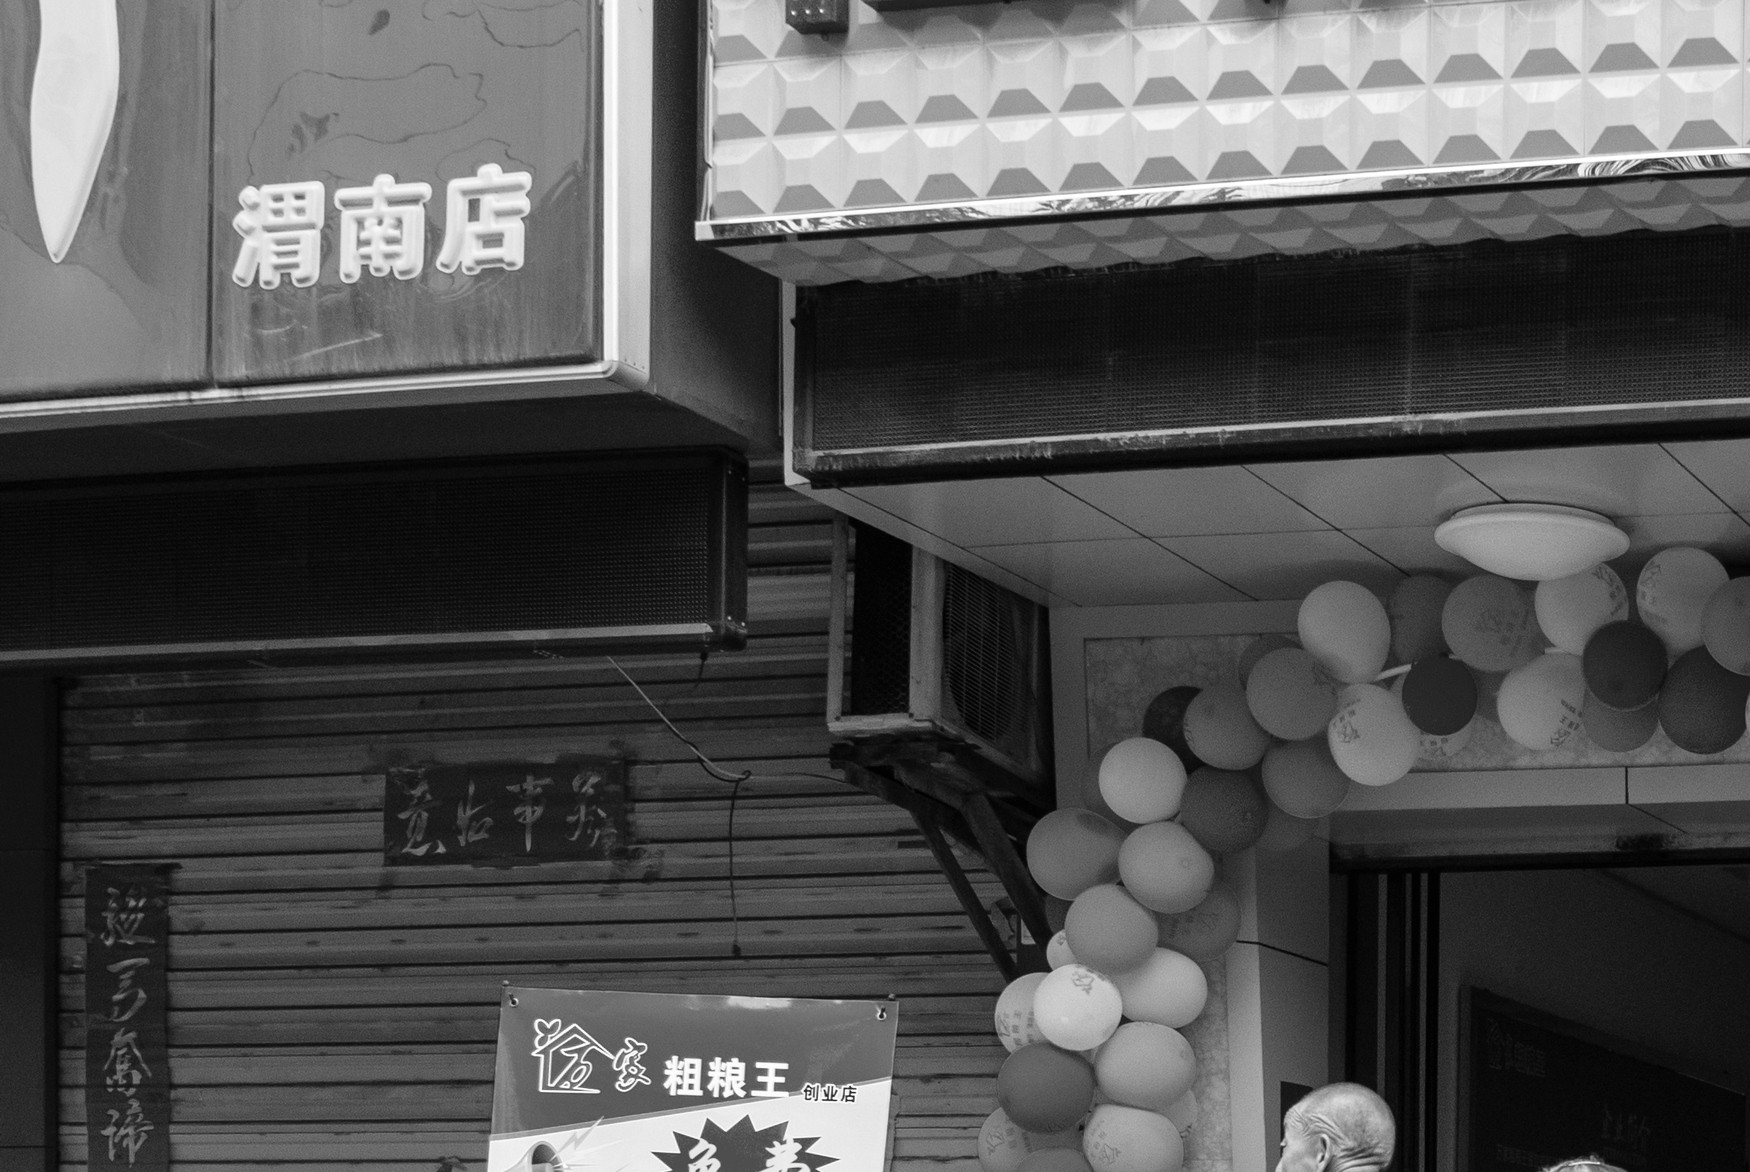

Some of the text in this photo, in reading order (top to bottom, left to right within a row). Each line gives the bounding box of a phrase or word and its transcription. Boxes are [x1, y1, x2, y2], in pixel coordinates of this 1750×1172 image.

[232, 163, 531, 290] 渭南店
[663, 1055, 791, 1099] 粗粮王
[802, 1084, 858, 1104] 创业店
